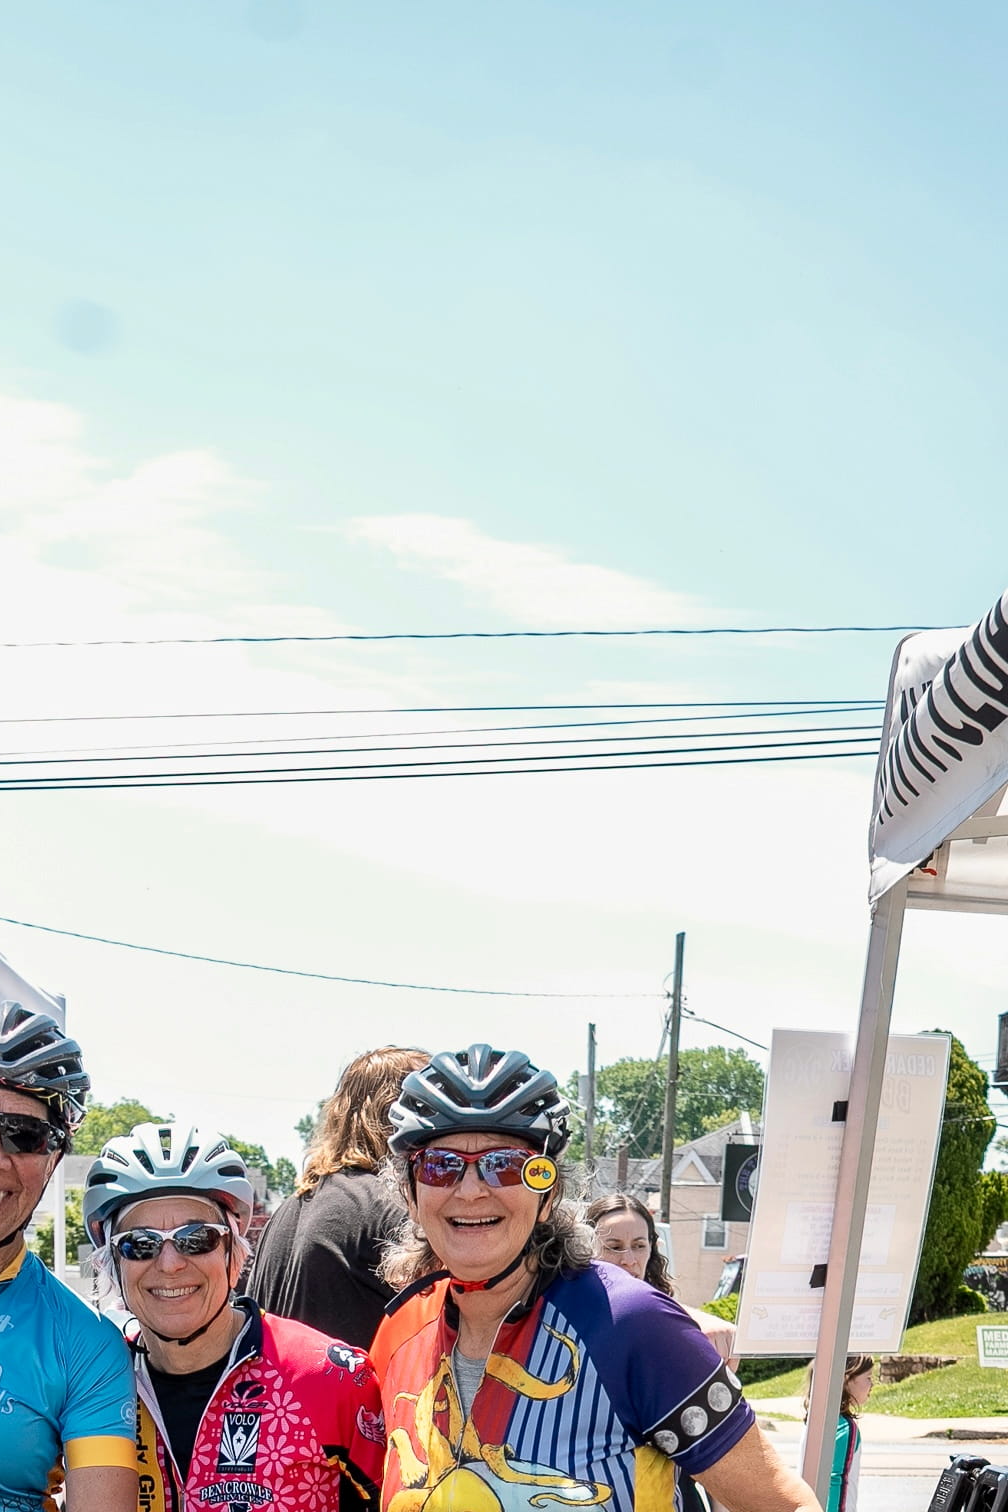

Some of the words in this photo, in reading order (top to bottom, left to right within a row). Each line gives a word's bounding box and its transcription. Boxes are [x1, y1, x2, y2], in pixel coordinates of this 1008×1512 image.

[229, 1413, 256, 1425] VOLO
[201, 1483, 223, 1500] BEN
[210, 1493, 263, 1505] SERVICES
